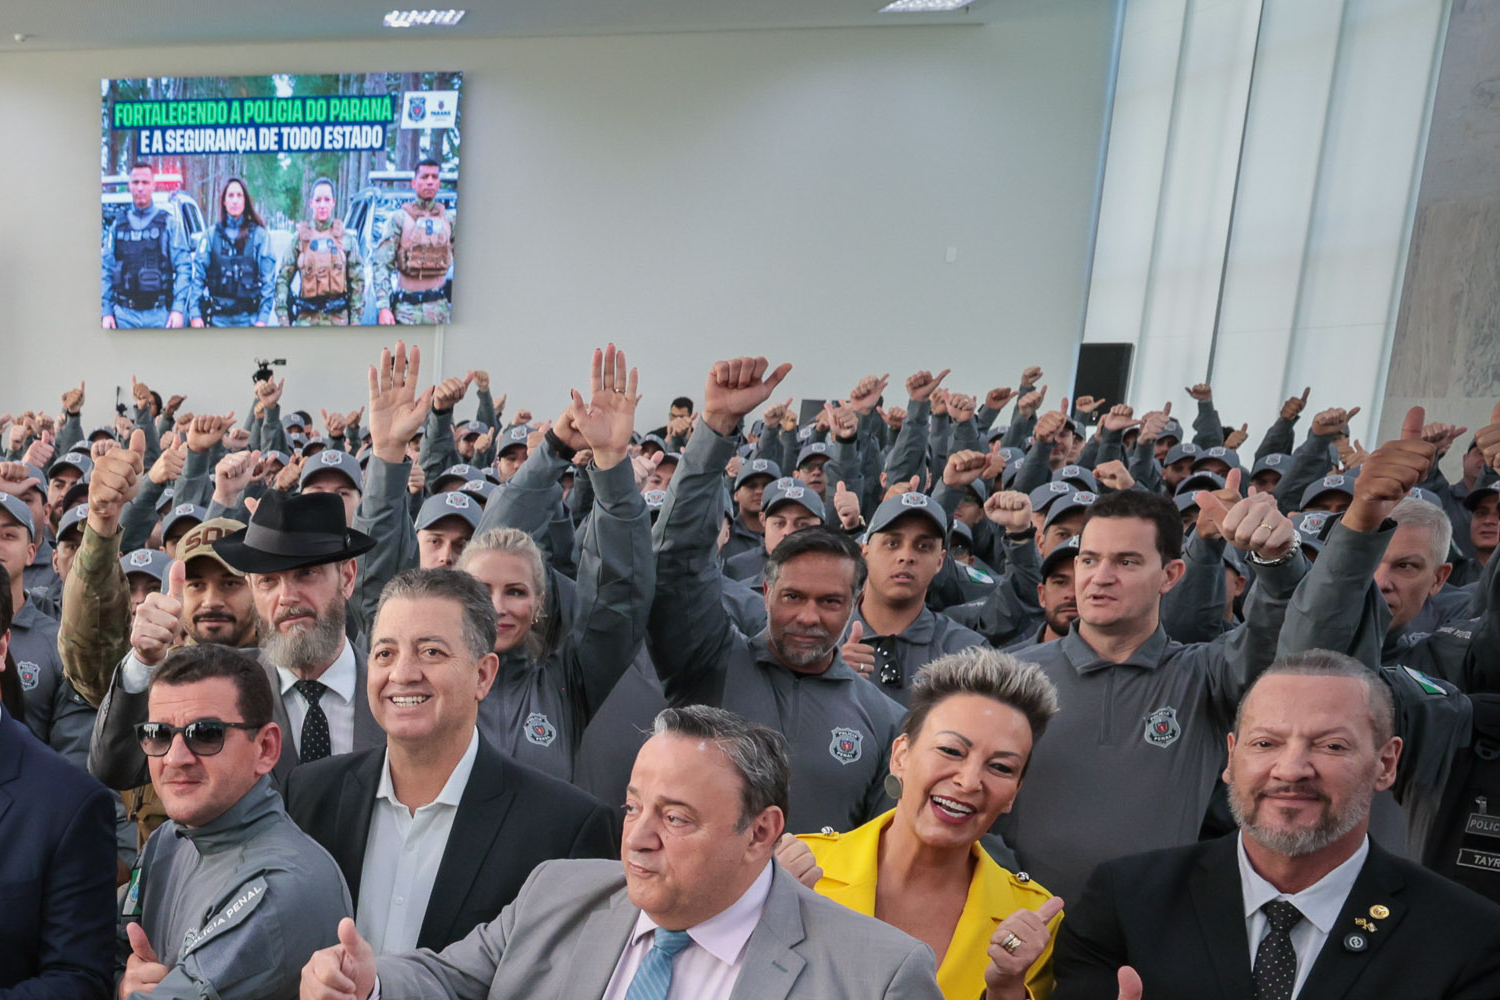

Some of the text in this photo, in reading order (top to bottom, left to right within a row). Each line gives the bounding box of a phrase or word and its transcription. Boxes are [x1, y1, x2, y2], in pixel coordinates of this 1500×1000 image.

[114, 95, 392, 127] FORTALECENDO A POLÍCIA DO PARANÁ
[140, 124, 383, 154] E A SEGURANÇA DE TODO ESTADO
[226, 886, 262, 919] PENAL
